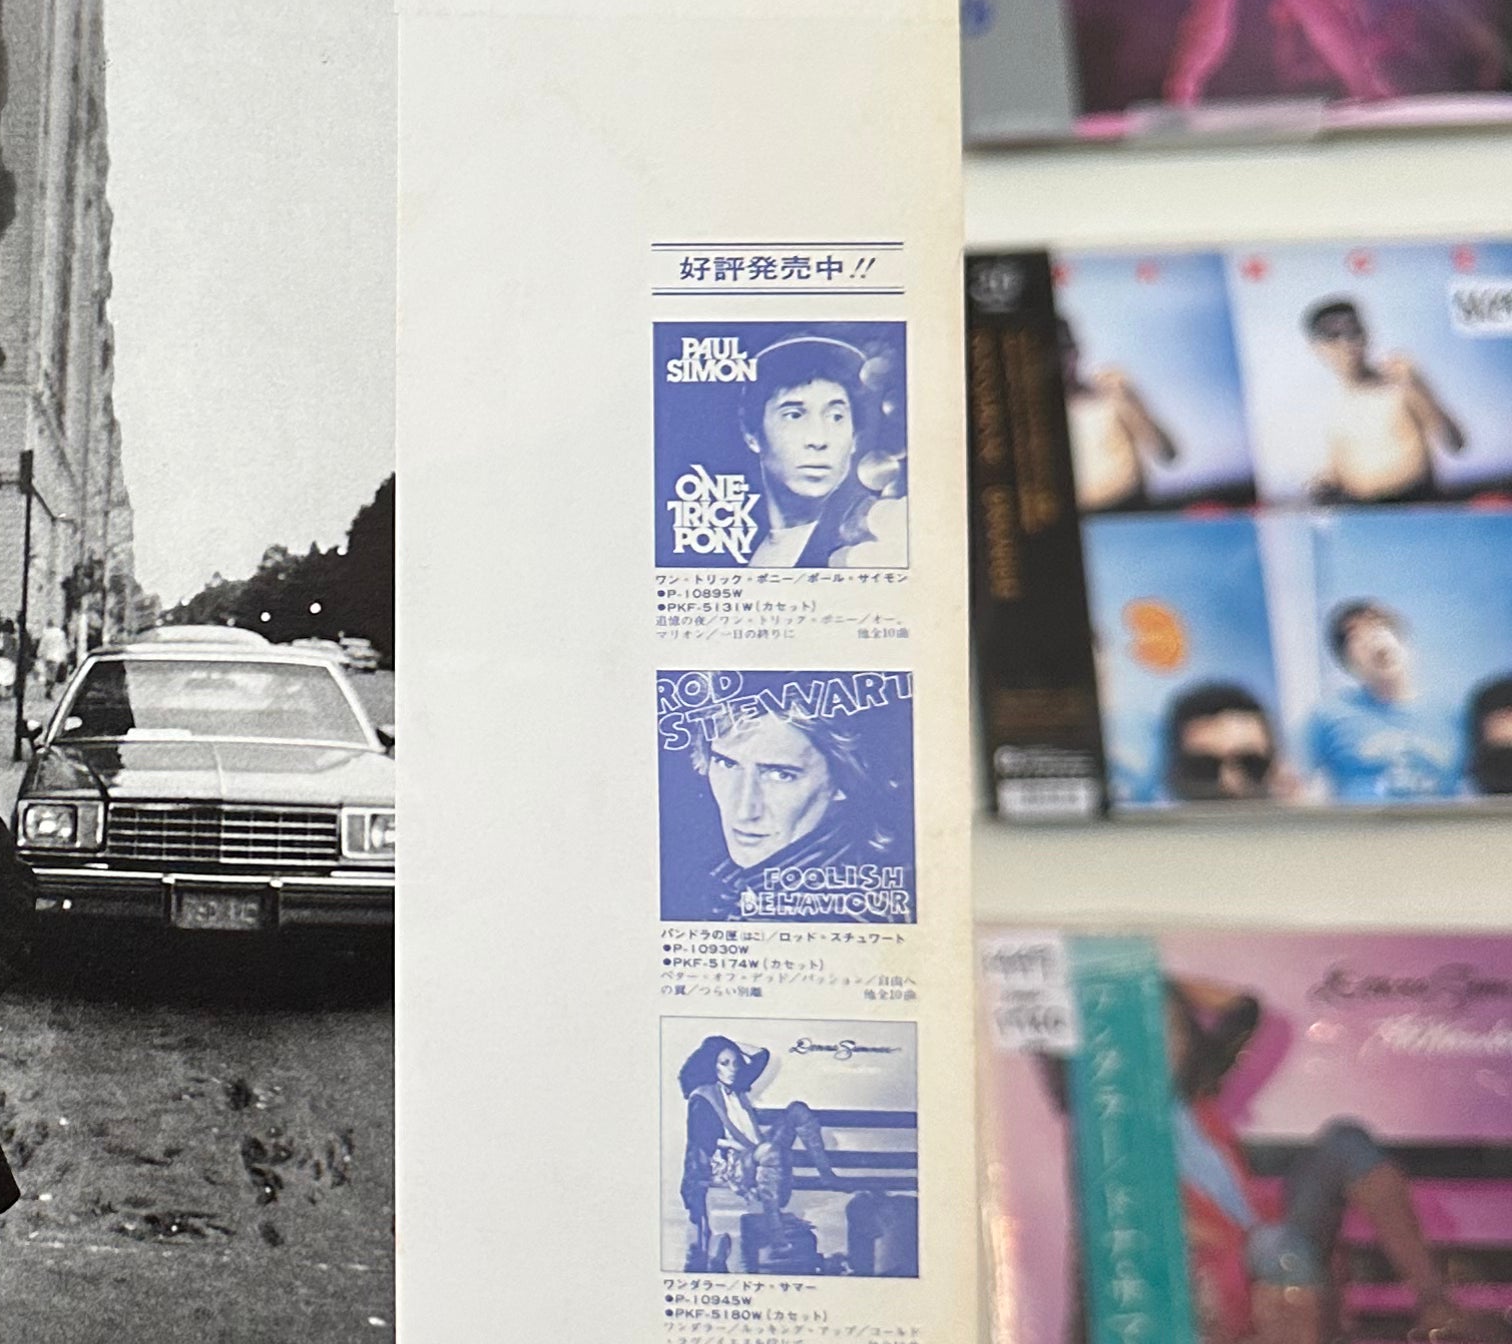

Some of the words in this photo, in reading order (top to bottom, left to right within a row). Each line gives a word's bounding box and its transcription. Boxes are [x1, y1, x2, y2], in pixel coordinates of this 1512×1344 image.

[681, 337, 747, 360] PAUL
[666, 358, 758, 382] SIMON
[667, 494, 760, 528] TRICK
[673, 527, 758, 563] PONY
[657, 671, 743, 714] ROD
[659, 672, 913, 750] STEWART
[763, 865, 904, 890] FOOLISH
[741, 891, 909, 917] BEHAVIOUR
